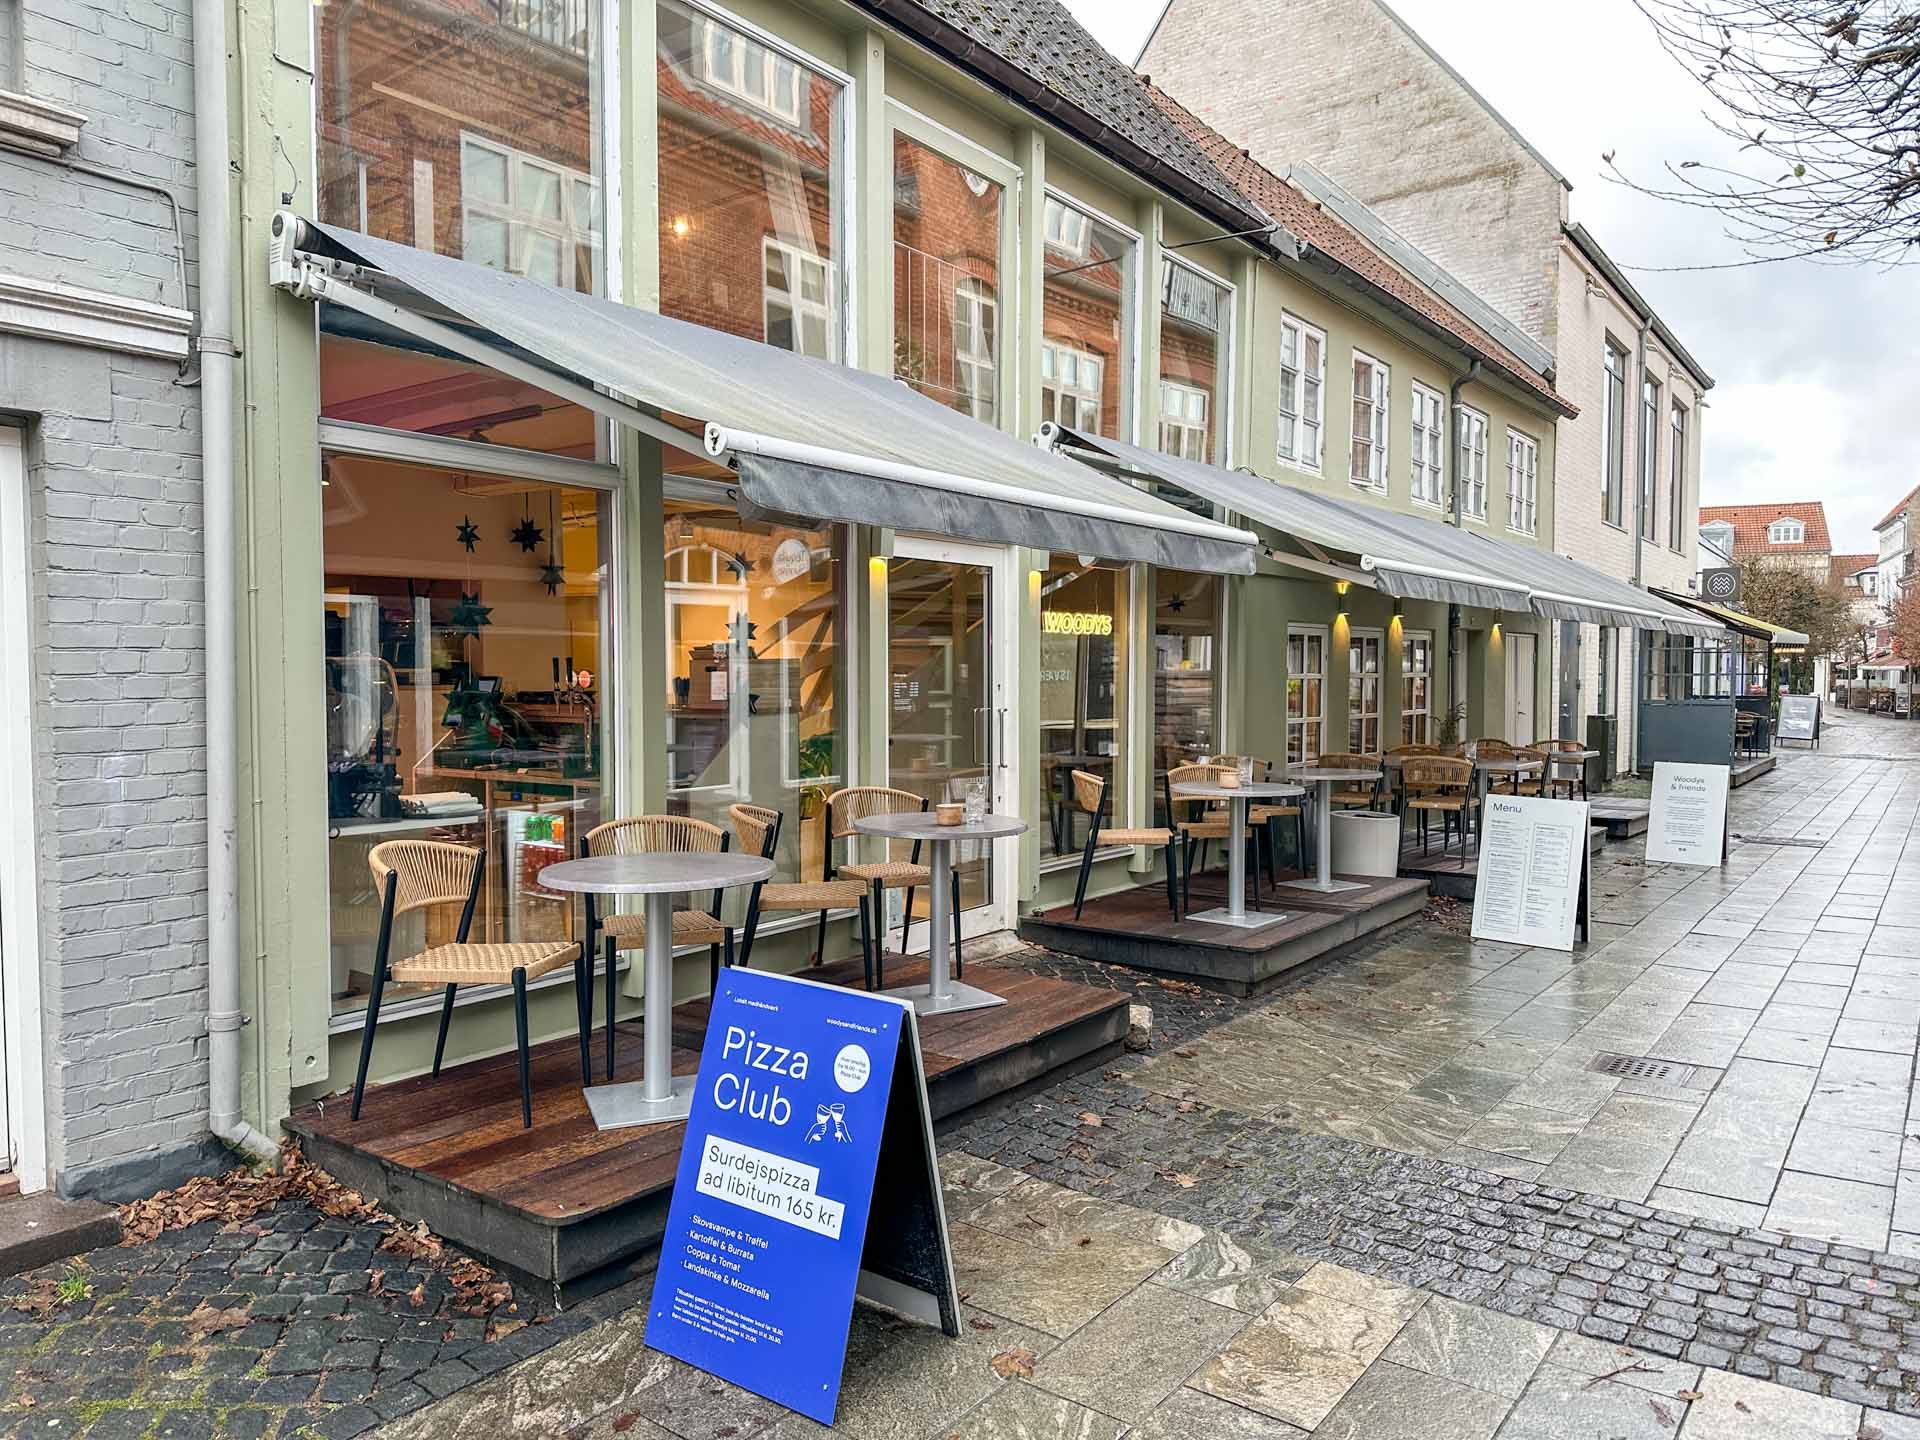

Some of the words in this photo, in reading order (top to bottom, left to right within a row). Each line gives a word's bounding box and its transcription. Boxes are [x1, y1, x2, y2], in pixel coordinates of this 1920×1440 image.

[1043, 611, 1112, 635] WOODYS
[1673, 775, 1705, 785] Woodys
[1493, 802, 1522, 814] Menu
[722, 1025, 809, 1080] Pizza
[713, 1072, 792, 1126] Club
[709, 1145, 810, 1192] Surdejspizza
[703, 1171, 724, 1189] ad
[727, 1175, 781, 1208] libitum
[787, 1196, 814, 1220] 165
[818, 1205, 837, 1229] kr.
[689, 1229, 720, 1248] Kartoffel
[720, 1241, 726, 1250] &
[727, 1243, 754, 1261] Burrata
[692, 1214, 736, 1238] Skovsvampe
[737, 1231, 743, 1240] &
[745, 1233, 769, 1249] Trøffel
[686, 1244, 710, 1261] Coppa
[711, 1254, 717, 1263] &
[719, 1256, 741, 1272] Tomat
[683, 1259, 722, 1281] Landskinke
[723, 1275, 729, 1284] &
[730, 1277, 770, 1300] Mozzarella
